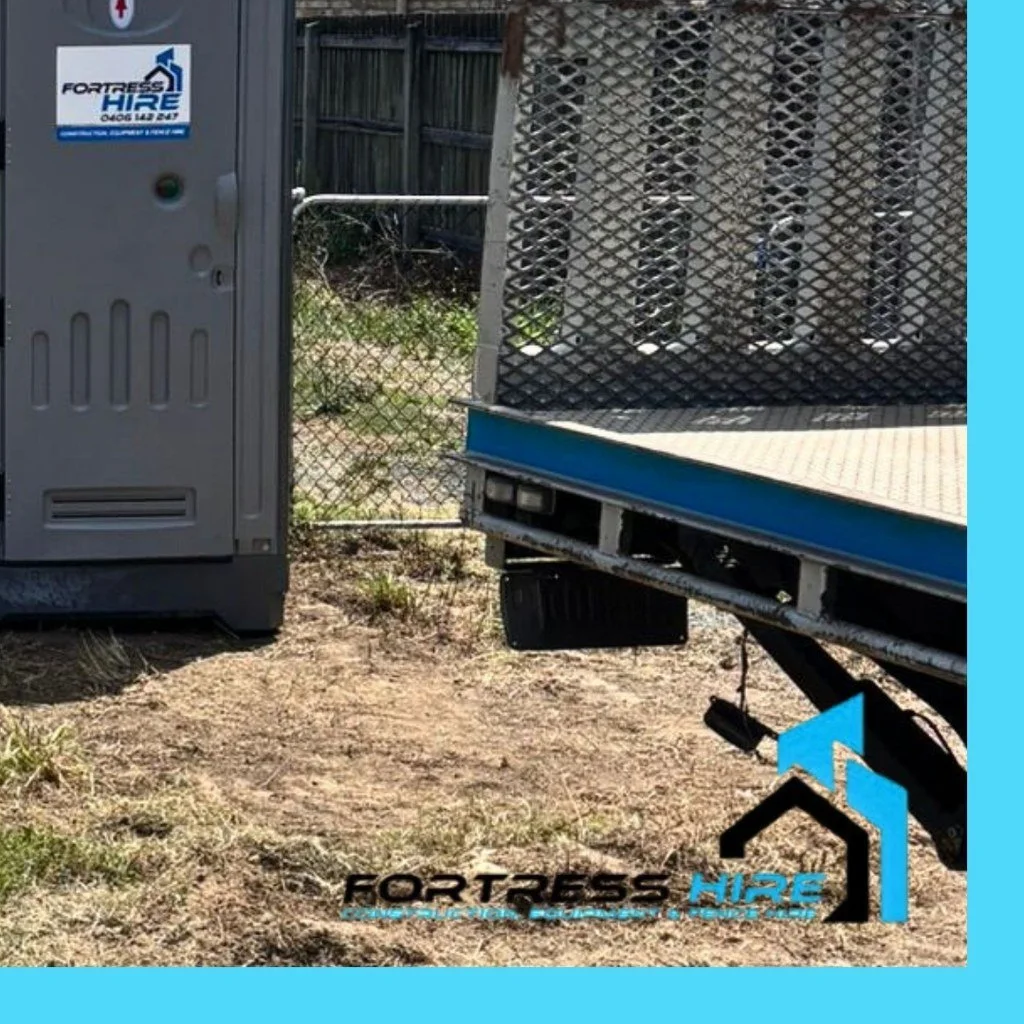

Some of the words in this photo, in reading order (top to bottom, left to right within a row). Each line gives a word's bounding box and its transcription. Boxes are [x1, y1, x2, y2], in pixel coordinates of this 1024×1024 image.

[61, 80, 164, 95] FORTRESS
[101, 93, 182, 112] HIRE
[100, 113, 132, 122] 0406
[134, 112, 155, 121] 142
[156, 112, 179, 121] 247
